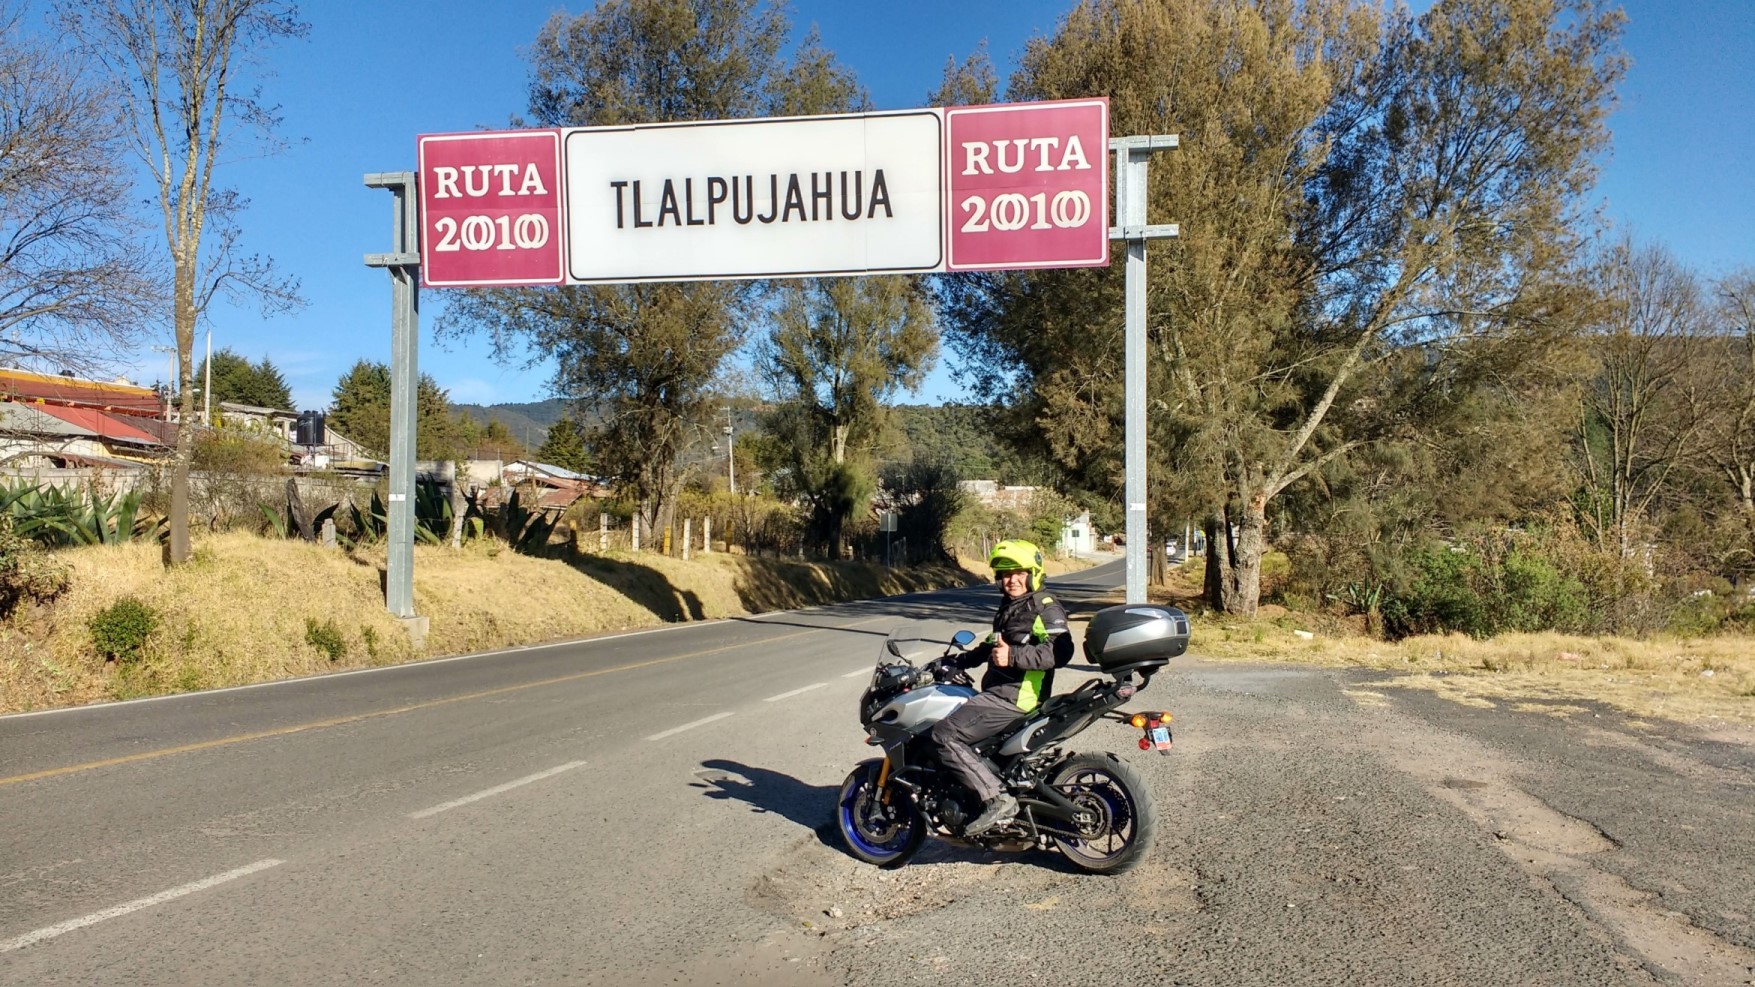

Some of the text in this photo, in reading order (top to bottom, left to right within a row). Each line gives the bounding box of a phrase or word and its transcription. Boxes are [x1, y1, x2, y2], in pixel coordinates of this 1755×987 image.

[961, 135, 1091, 175] RUTA
[433, 163, 548, 198] RUTA
[610, 169, 893, 229] TLALPUJAHUA
[960, 190, 1091, 233] 2010
[434, 213, 549, 251] 2010
